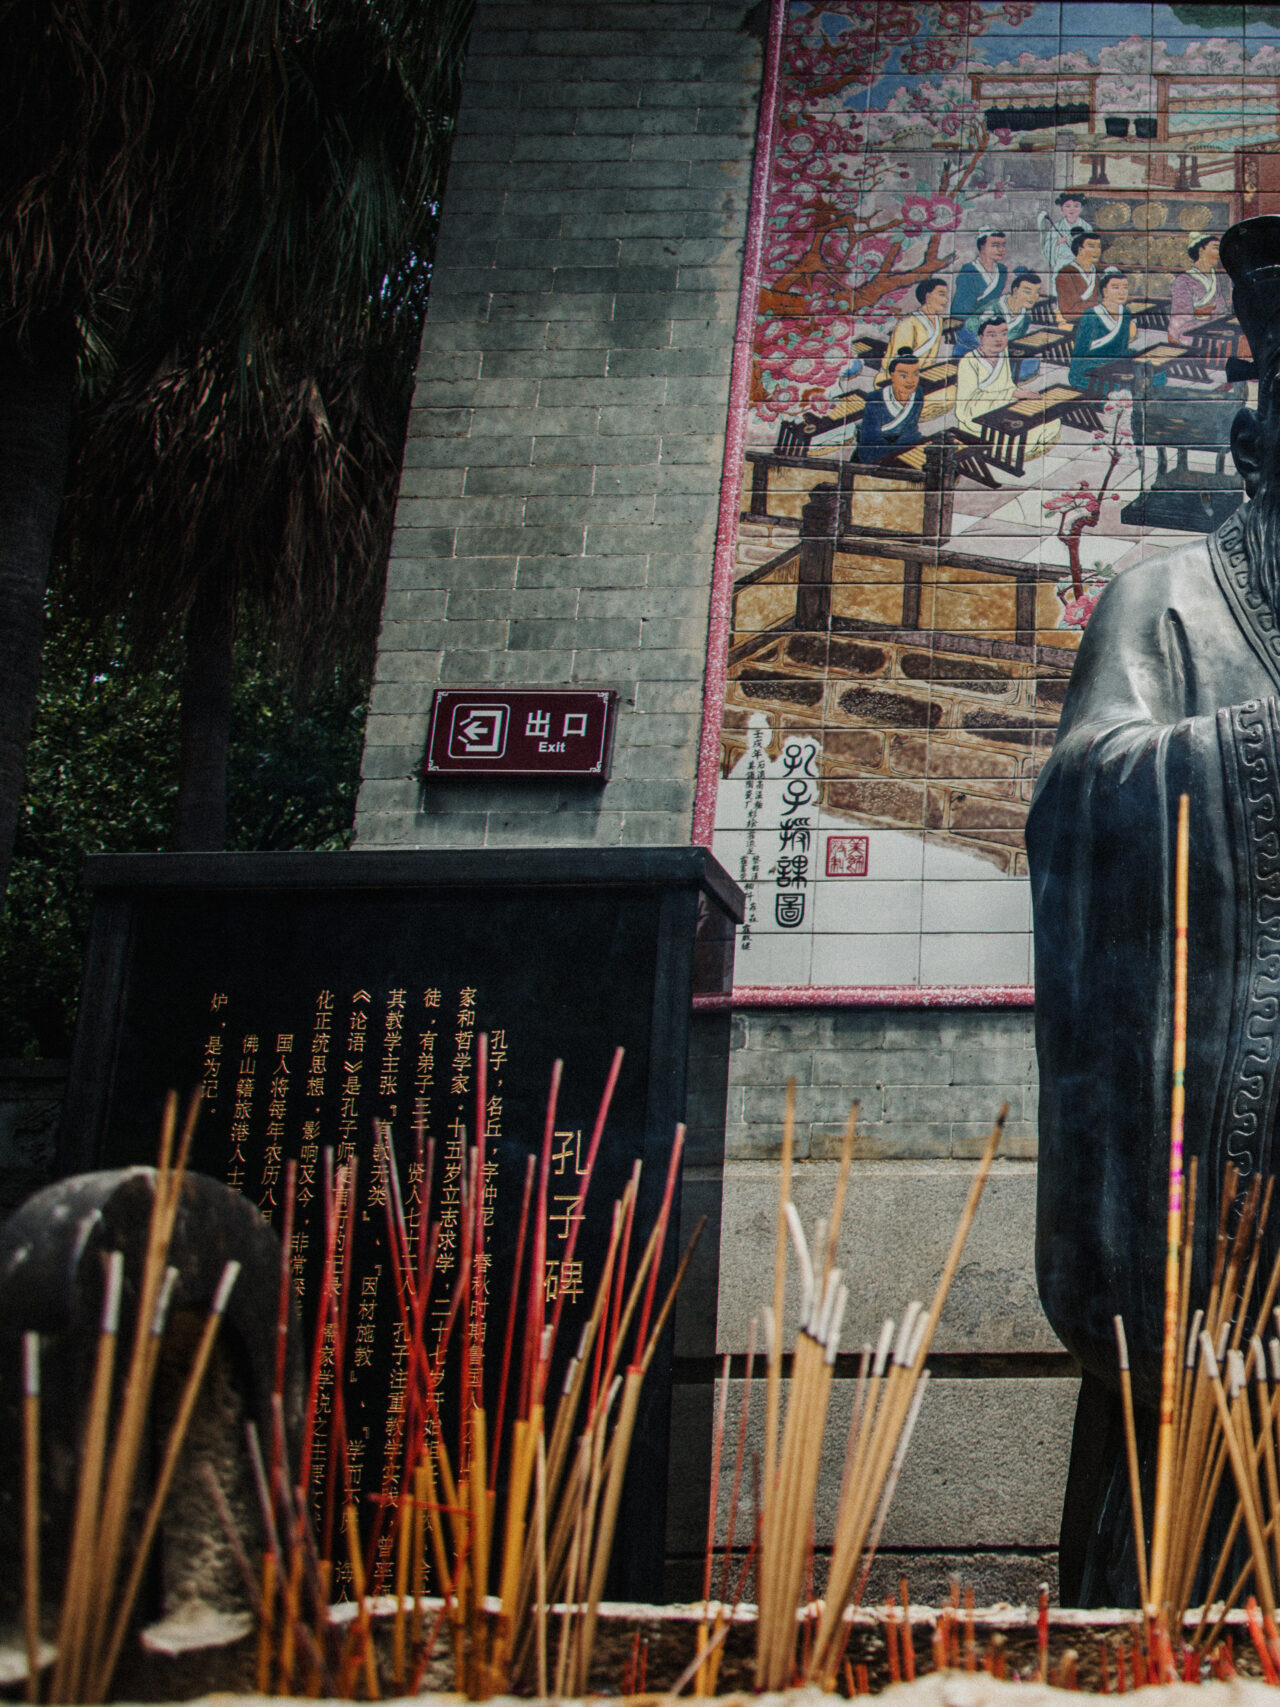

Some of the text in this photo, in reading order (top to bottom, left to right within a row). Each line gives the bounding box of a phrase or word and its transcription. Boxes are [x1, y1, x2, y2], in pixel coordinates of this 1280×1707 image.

[525, 709, 588, 738] 出口
[538, 741, 566, 753] Exit
[543, 1129, 590, 1305] 孔子碑
